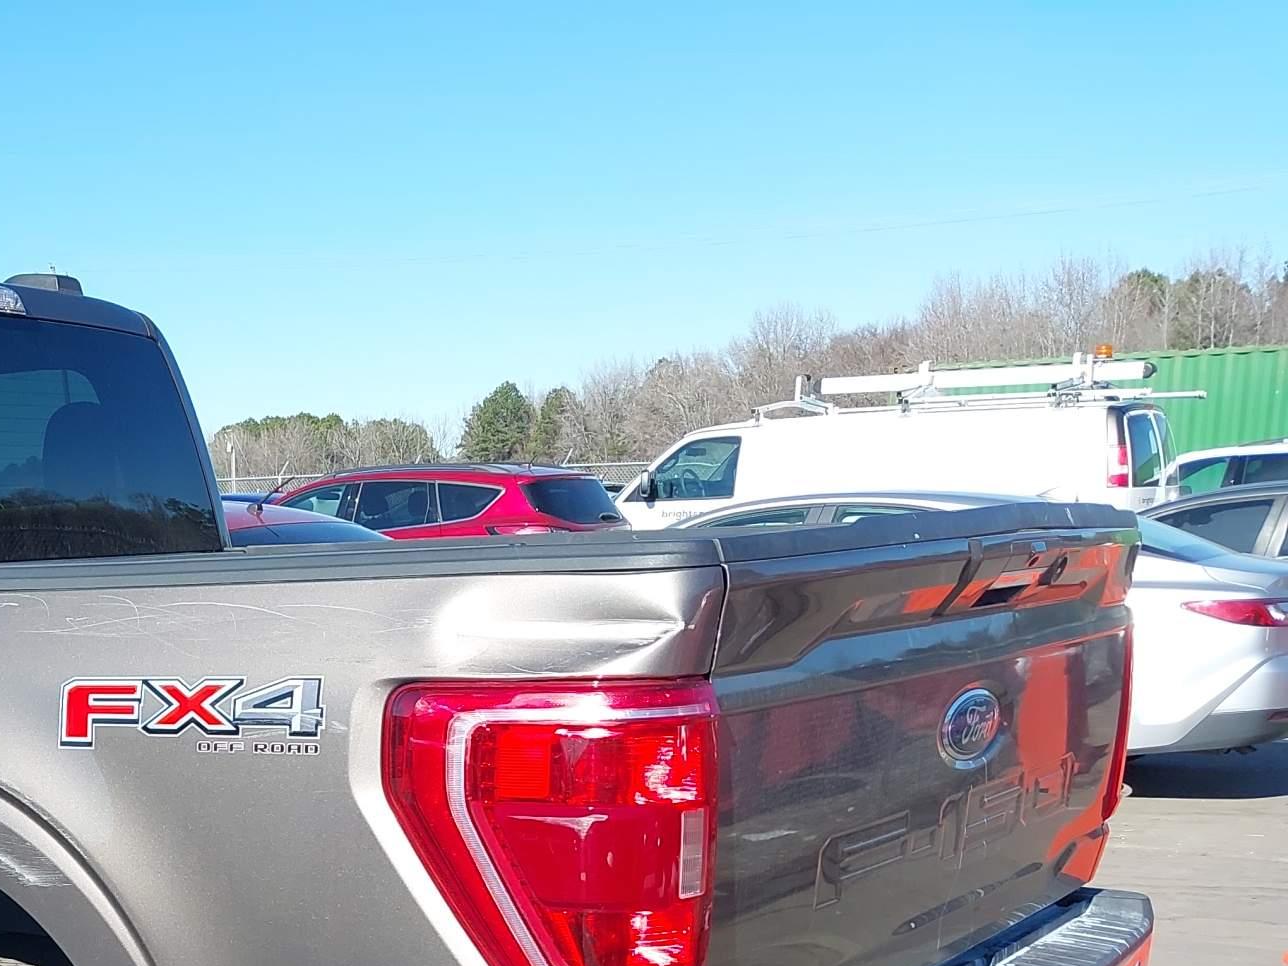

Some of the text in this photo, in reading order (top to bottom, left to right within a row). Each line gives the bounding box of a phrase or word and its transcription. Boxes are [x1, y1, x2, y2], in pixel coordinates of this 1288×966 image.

[58, 676, 324, 749] FX4
[960, 705, 994, 745] Ford
[196, 740, 321, 755] OFF ROAD
